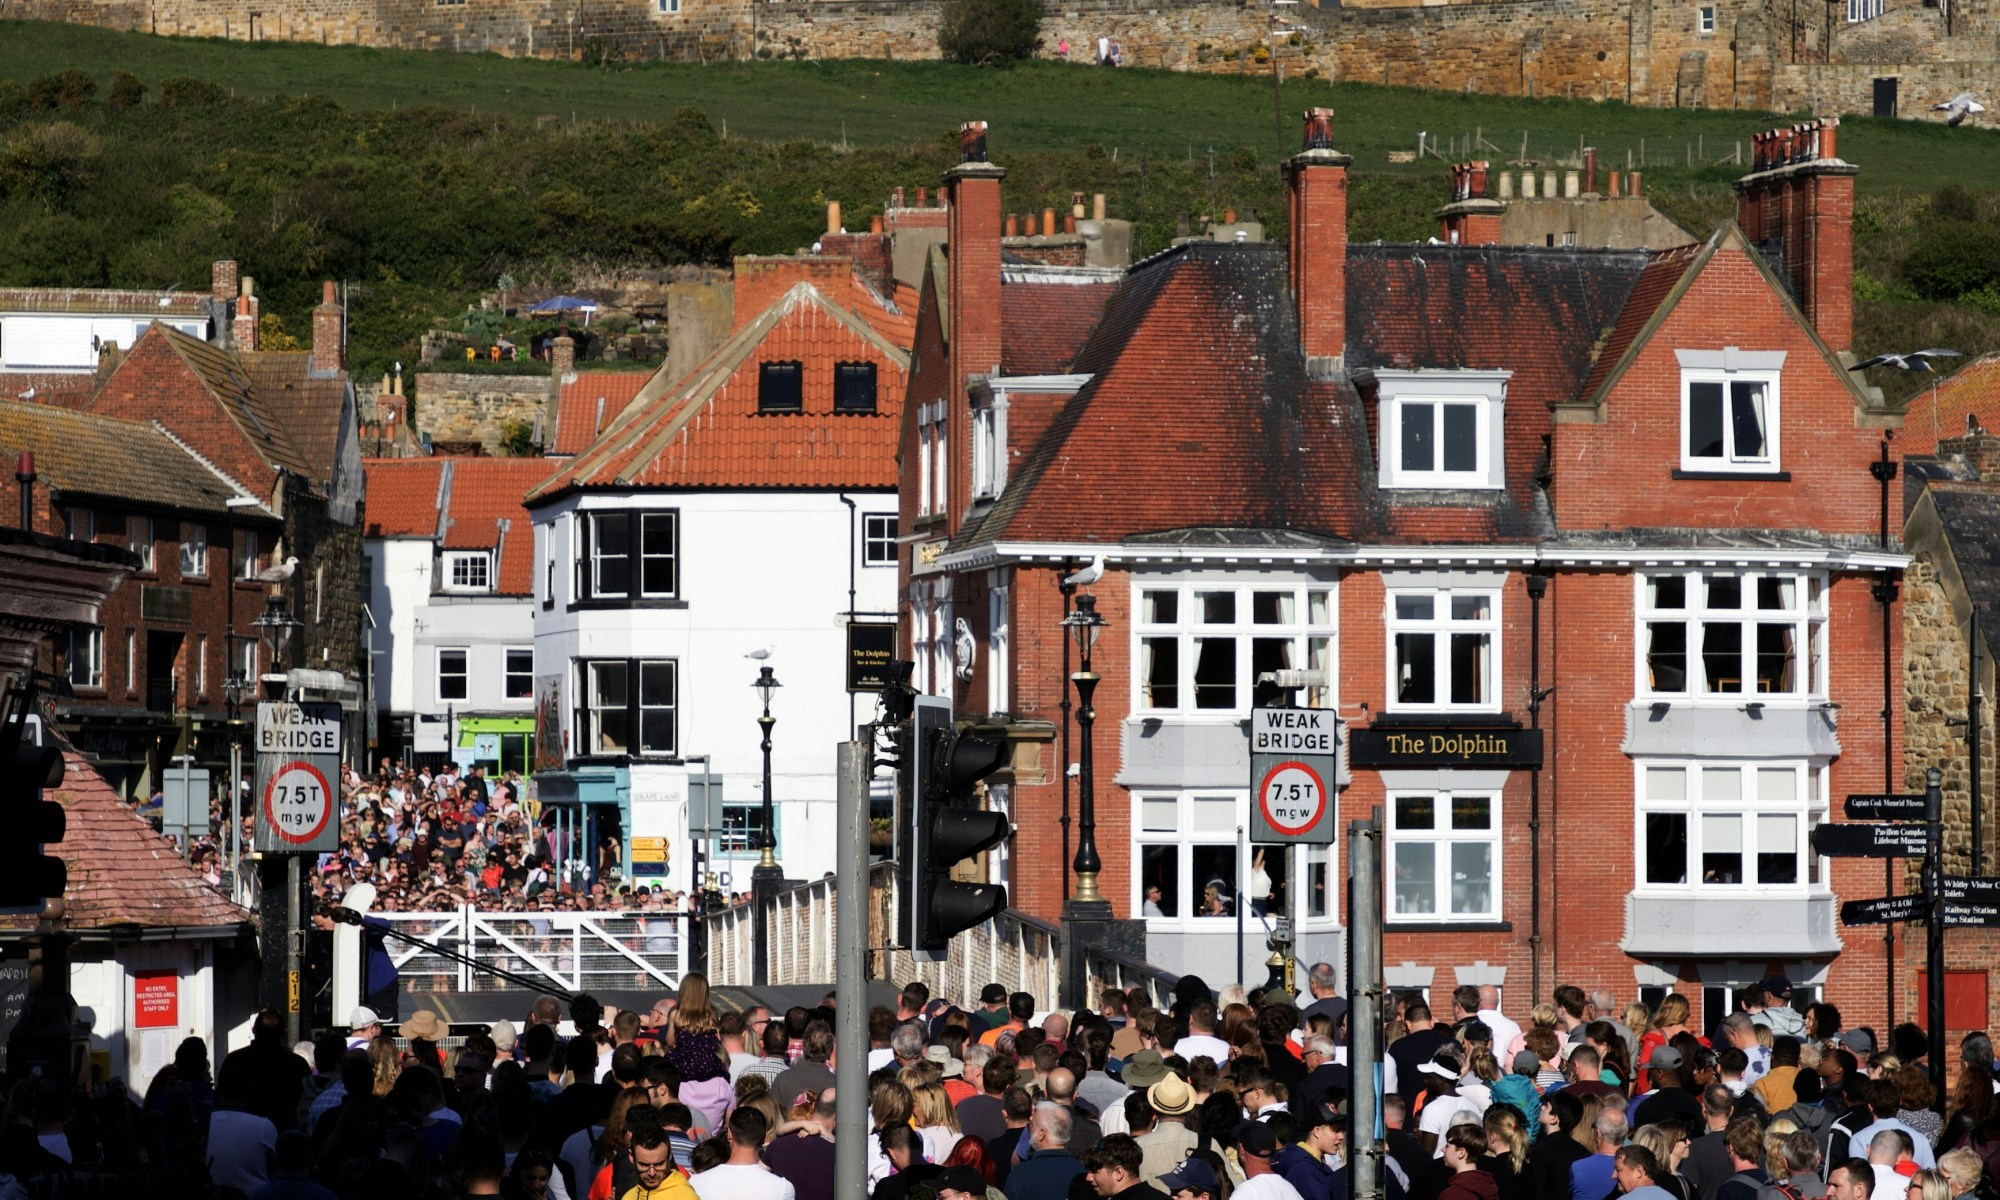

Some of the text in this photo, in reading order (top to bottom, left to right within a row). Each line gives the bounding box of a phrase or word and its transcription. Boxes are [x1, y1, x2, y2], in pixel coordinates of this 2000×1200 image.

[272, 707, 326, 726] WEAK
[1267, 712, 1320, 728] WEAK
[262, 730, 334, 748] BRIDGE
[1258, 732, 1329, 750] BRIDGE
[1386, 734, 1508, 758] The Dolphin
[1852, 799, 1870, 808] Captain
[1900, 828, 1926, 837] Complex
[1944, 880, 1969, 890] Whitby
[1971, 881, 1994, 889] Visitor
[1876, 901, 1890, 910] Abbey
[1945, 906, 1998, 915] Railway Station
[1960, 916, 1984, 924] Station
